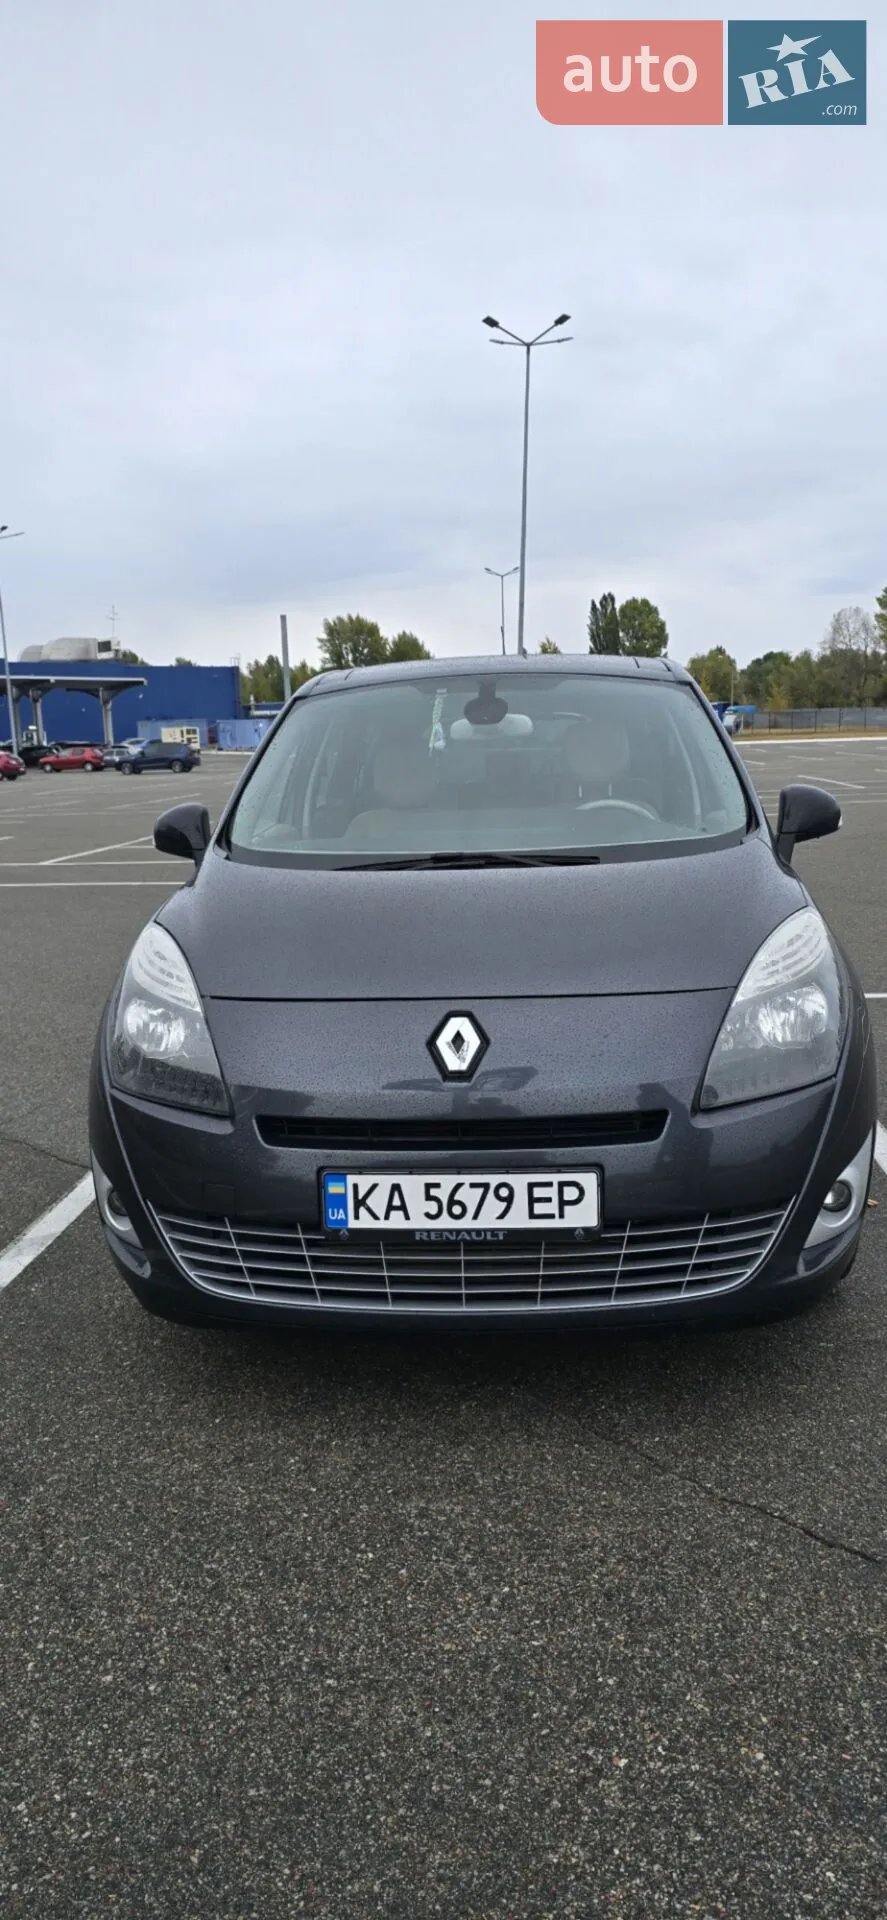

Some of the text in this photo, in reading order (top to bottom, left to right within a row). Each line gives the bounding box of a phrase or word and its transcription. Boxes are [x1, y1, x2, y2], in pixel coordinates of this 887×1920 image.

[352, 1180, 586, 1221] KA 5679 EP
[328, 1208, 346, 1220] UA
[414, 1230, 508, 1241] RENAULT
